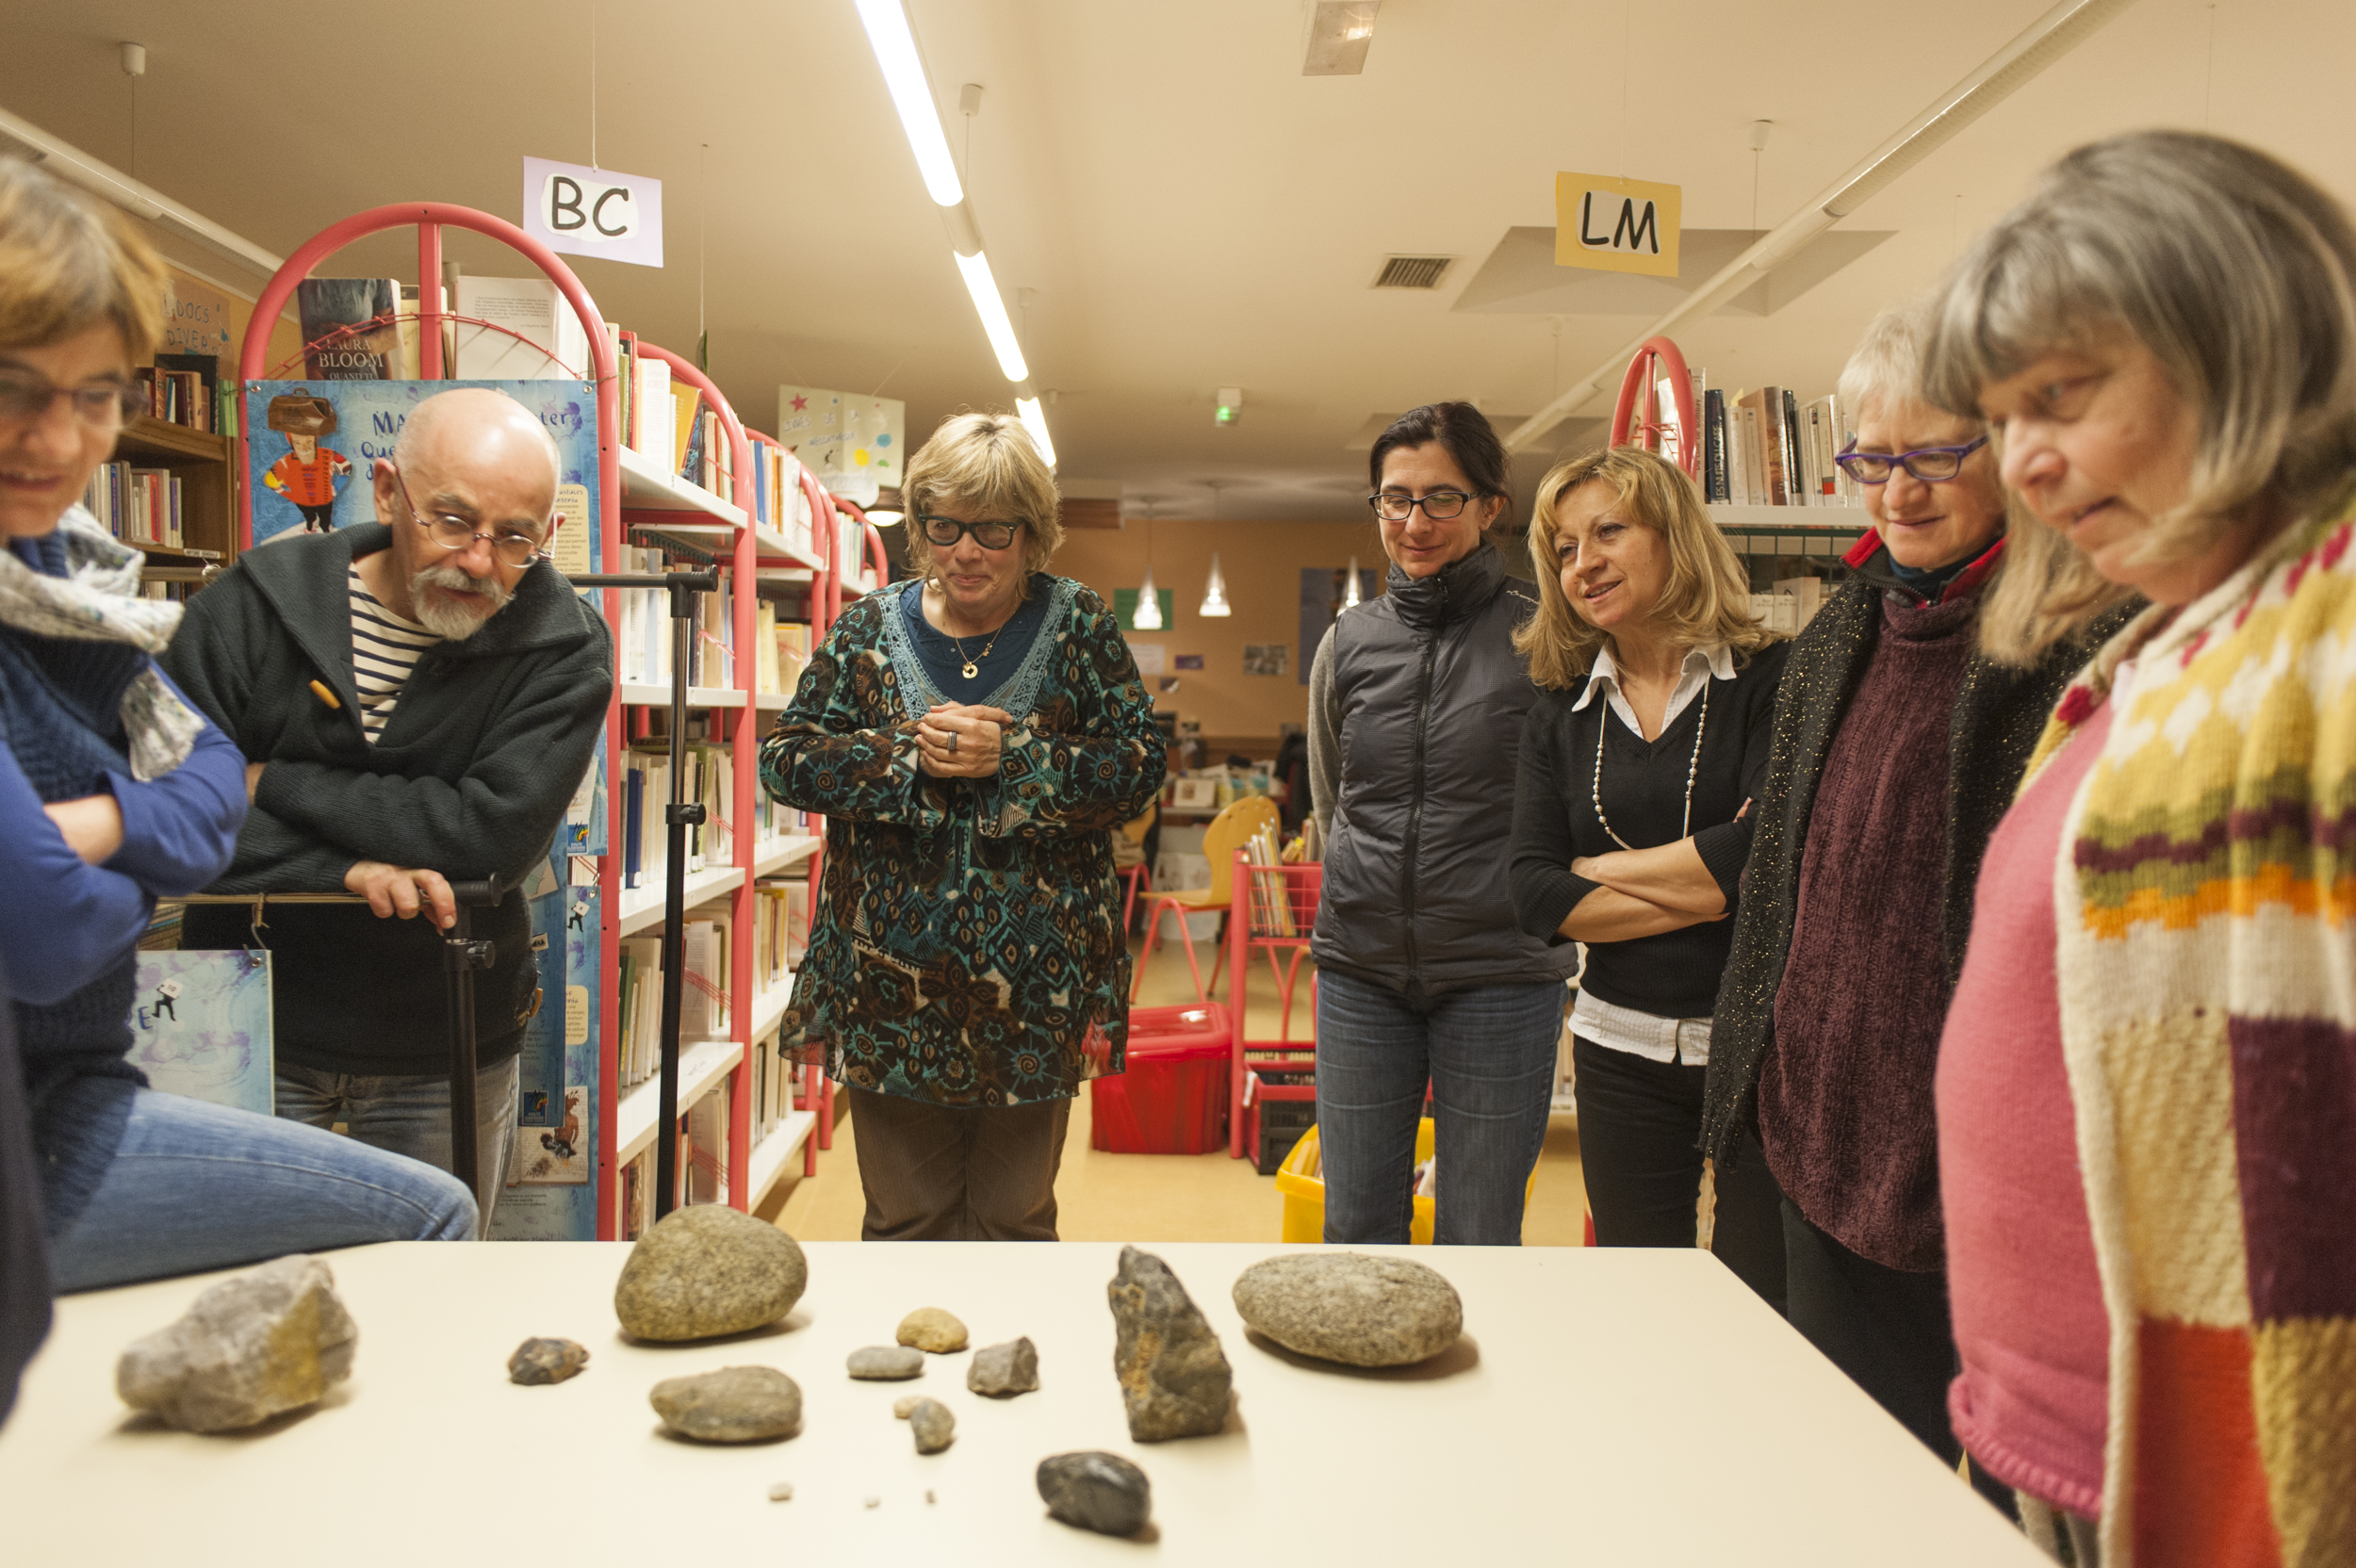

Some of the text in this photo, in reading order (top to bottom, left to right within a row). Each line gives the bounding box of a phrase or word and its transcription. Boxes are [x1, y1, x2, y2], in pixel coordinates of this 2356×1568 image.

[552, 176, 629, 237] BC
[1582, 191, 1659, 253] LM
[176, 300, 209, 323] DOCS
[327, 338, 371, 351] LAURA
[319, 352, 384, 368] BLOOM
[540, 412, 568, 426] ter
[1716, 486, 1725, 499] LES
